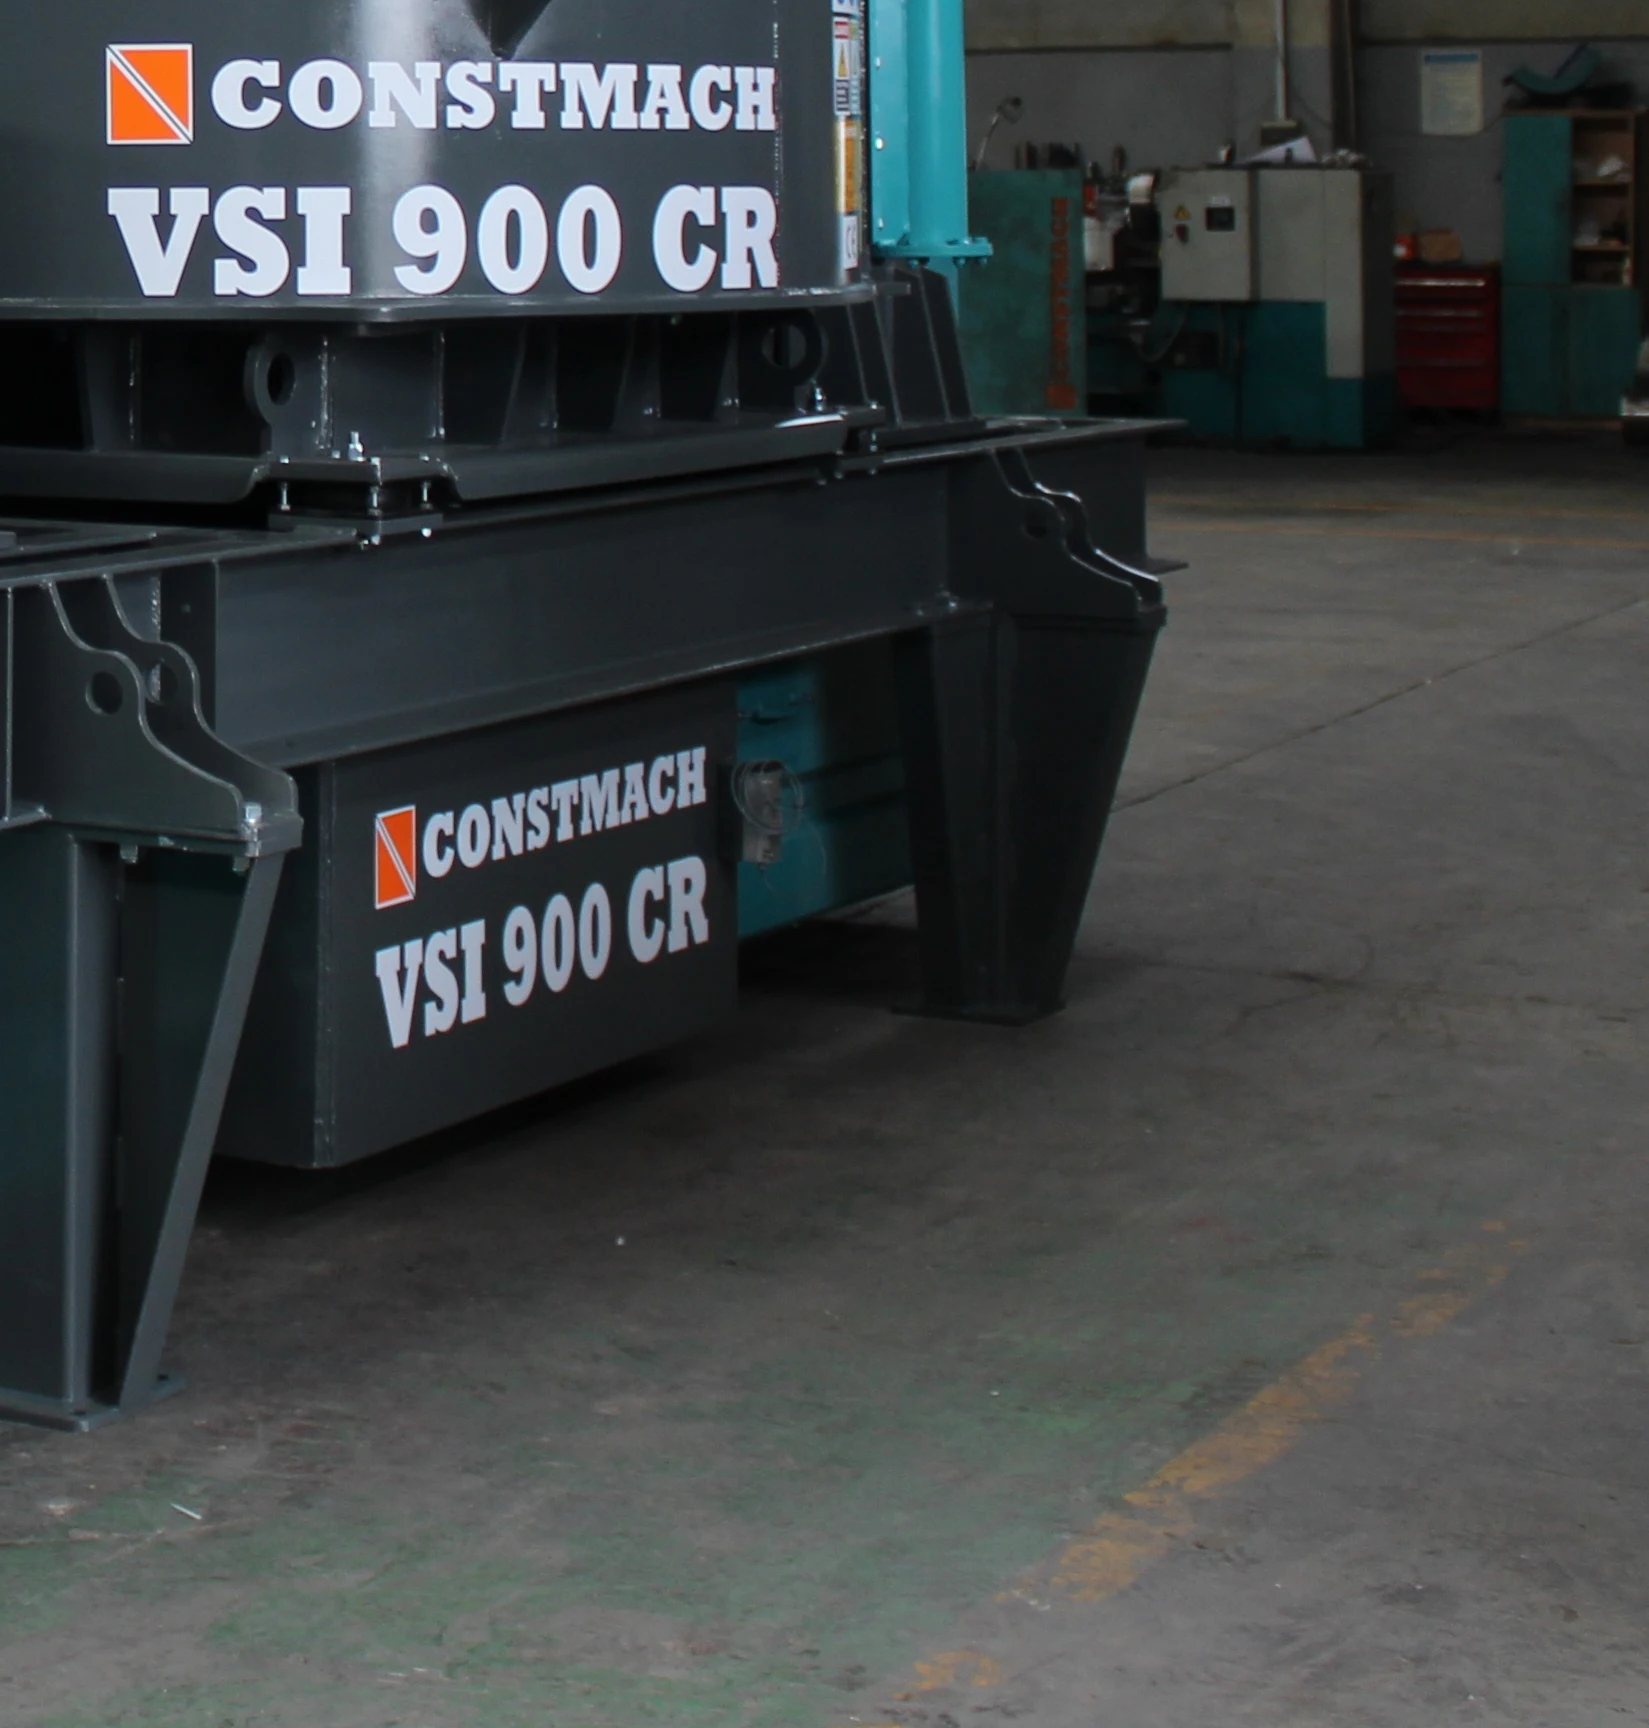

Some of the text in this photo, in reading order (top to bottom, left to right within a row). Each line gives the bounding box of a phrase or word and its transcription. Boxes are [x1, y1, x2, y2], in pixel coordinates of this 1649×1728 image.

[211, 58, 777, 131] CONSTMACH
[107, 184, 779, 297] VSI 900 CR
[422, 746, 707, 879] CONSTMACH
[375, 854, 709, 1050] VSI 900 CR
